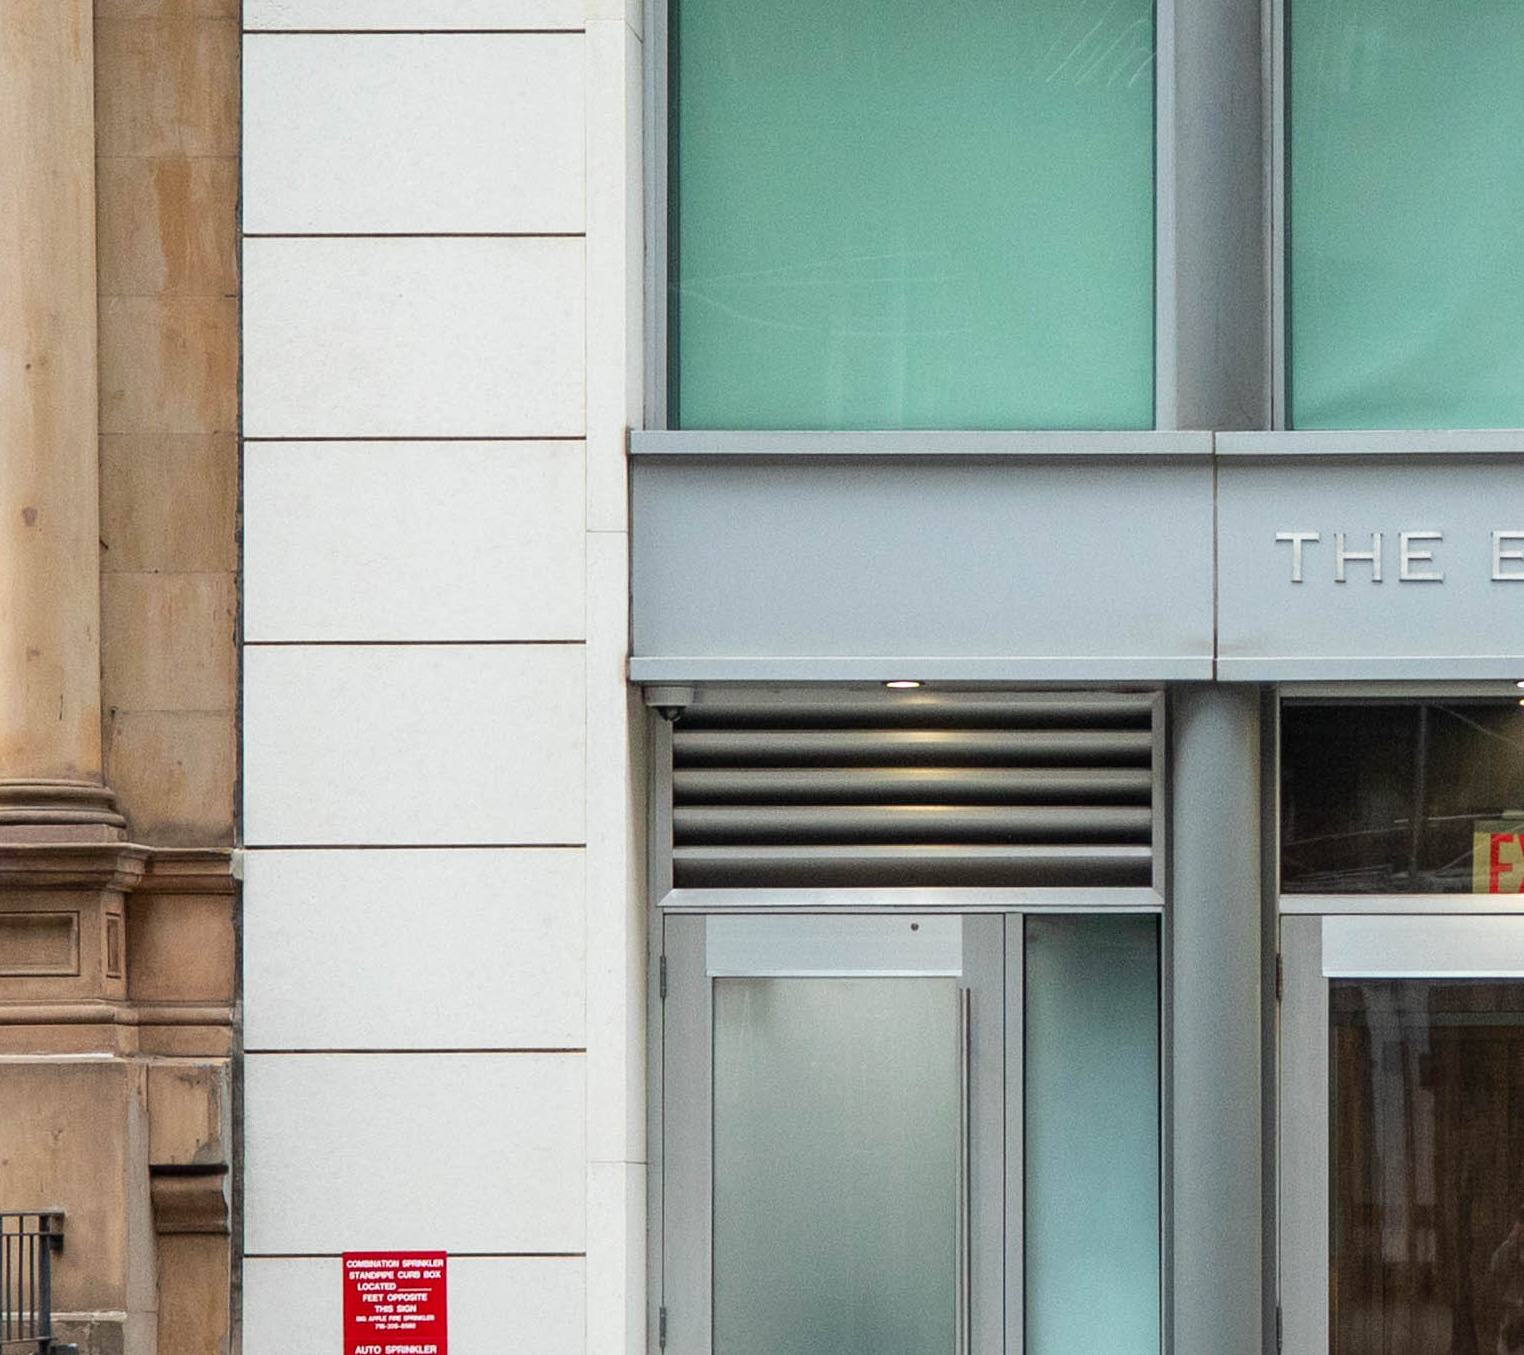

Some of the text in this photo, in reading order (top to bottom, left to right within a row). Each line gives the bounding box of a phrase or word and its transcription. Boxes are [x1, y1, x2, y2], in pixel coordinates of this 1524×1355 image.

[1275, 531, 1444, 583] THE
[346, 1259, 444, 1268] COMBINATION SPRINKLER
[349, 1270, 441, 1279] STANDPIPE CURB BOX
[357, 1282, 396, 1291] LOCATED
[362, 1293, 428, 1302] FEET OPPOSITE
[375, 1304, 417, 1313] THIS SIGN
[355, 1345, 437, 1354] AUTO SPRINKLER
